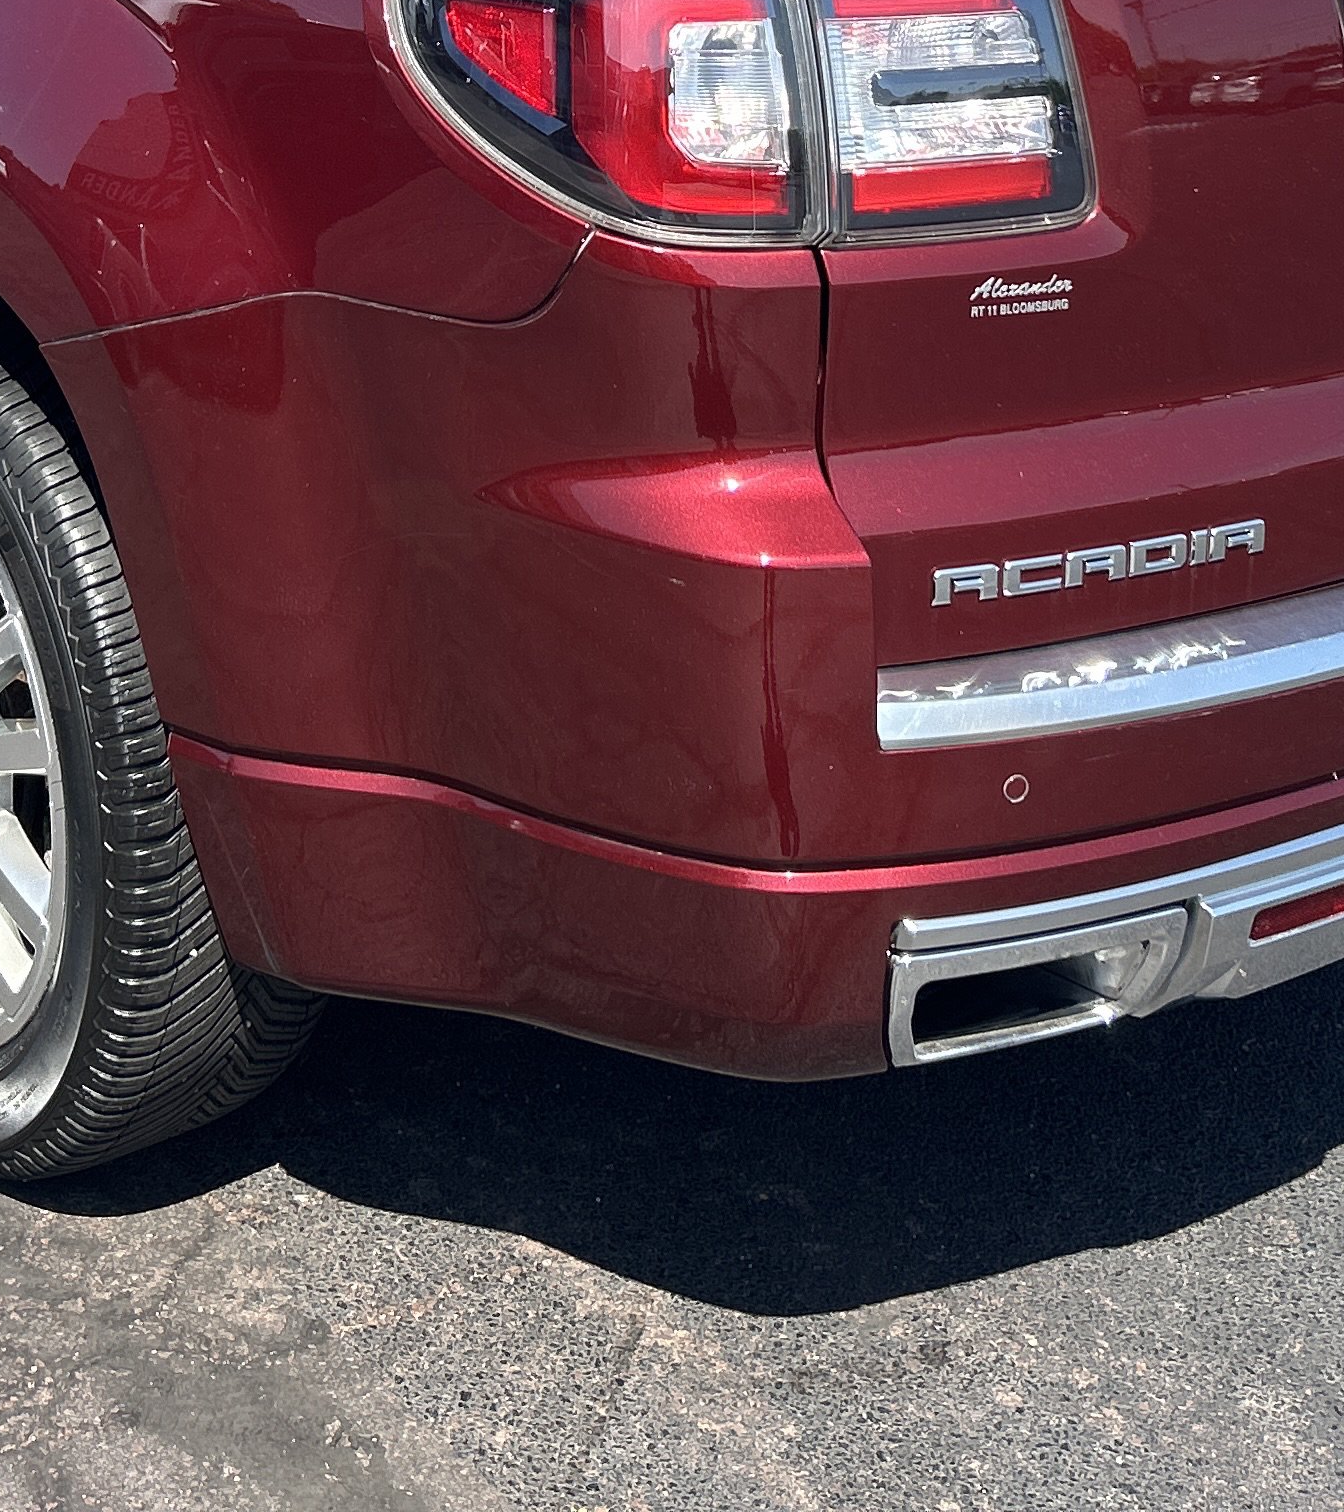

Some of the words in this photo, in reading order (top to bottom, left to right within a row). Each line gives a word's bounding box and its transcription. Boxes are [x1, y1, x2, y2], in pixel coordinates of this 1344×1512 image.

[969, 273, 1074, 302] Alexander
[970, 304, 986, 318] RT
[986, 304, 998, 317] 11
[999, 298, 1070, 316] BLOOMSBURG
[931, 517, 1266, 607] ACADIA
